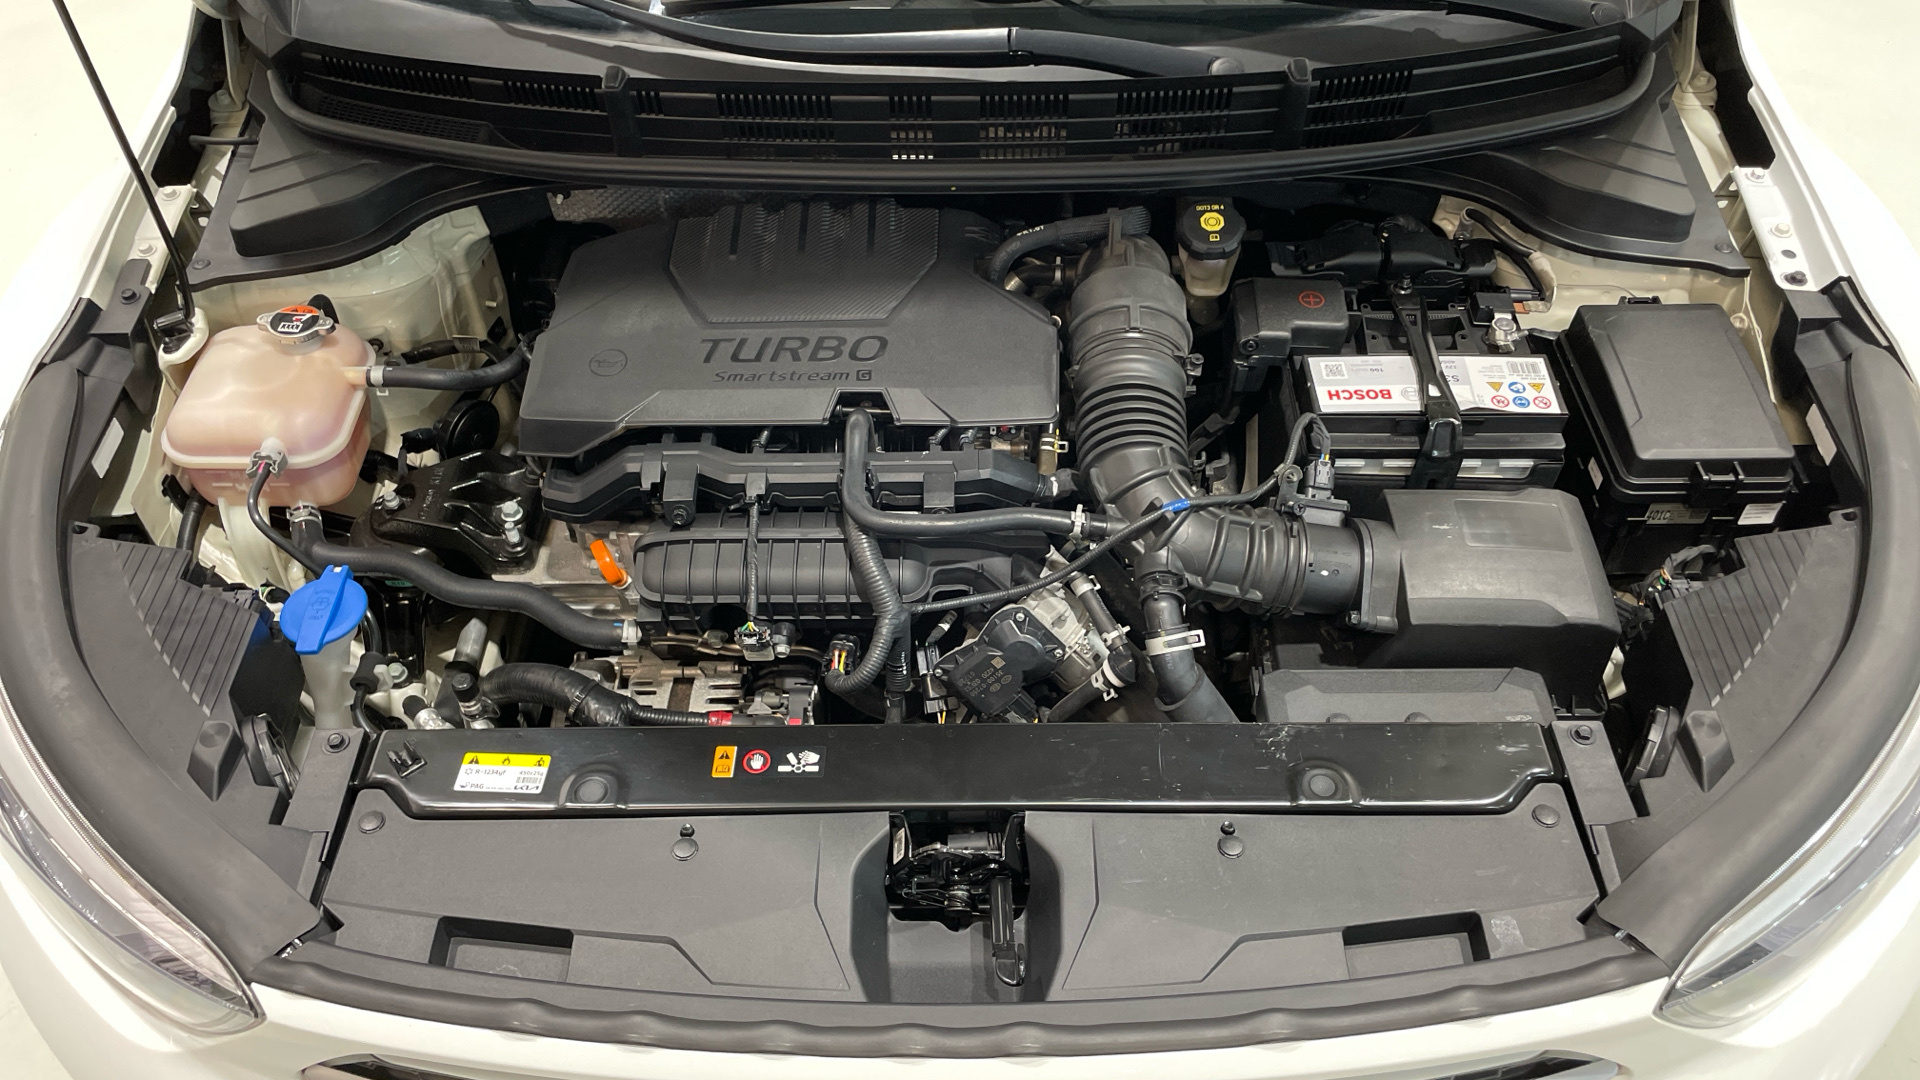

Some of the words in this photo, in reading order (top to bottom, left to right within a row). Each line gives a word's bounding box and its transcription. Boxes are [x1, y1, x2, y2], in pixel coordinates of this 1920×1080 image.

[700, 335, 889, 364] TURBO
[712, 370, 850, 383] Smartstream
[1327, 389, 1393, 401] BOSCH
[475, 768, 507, 776] R-1234yf
